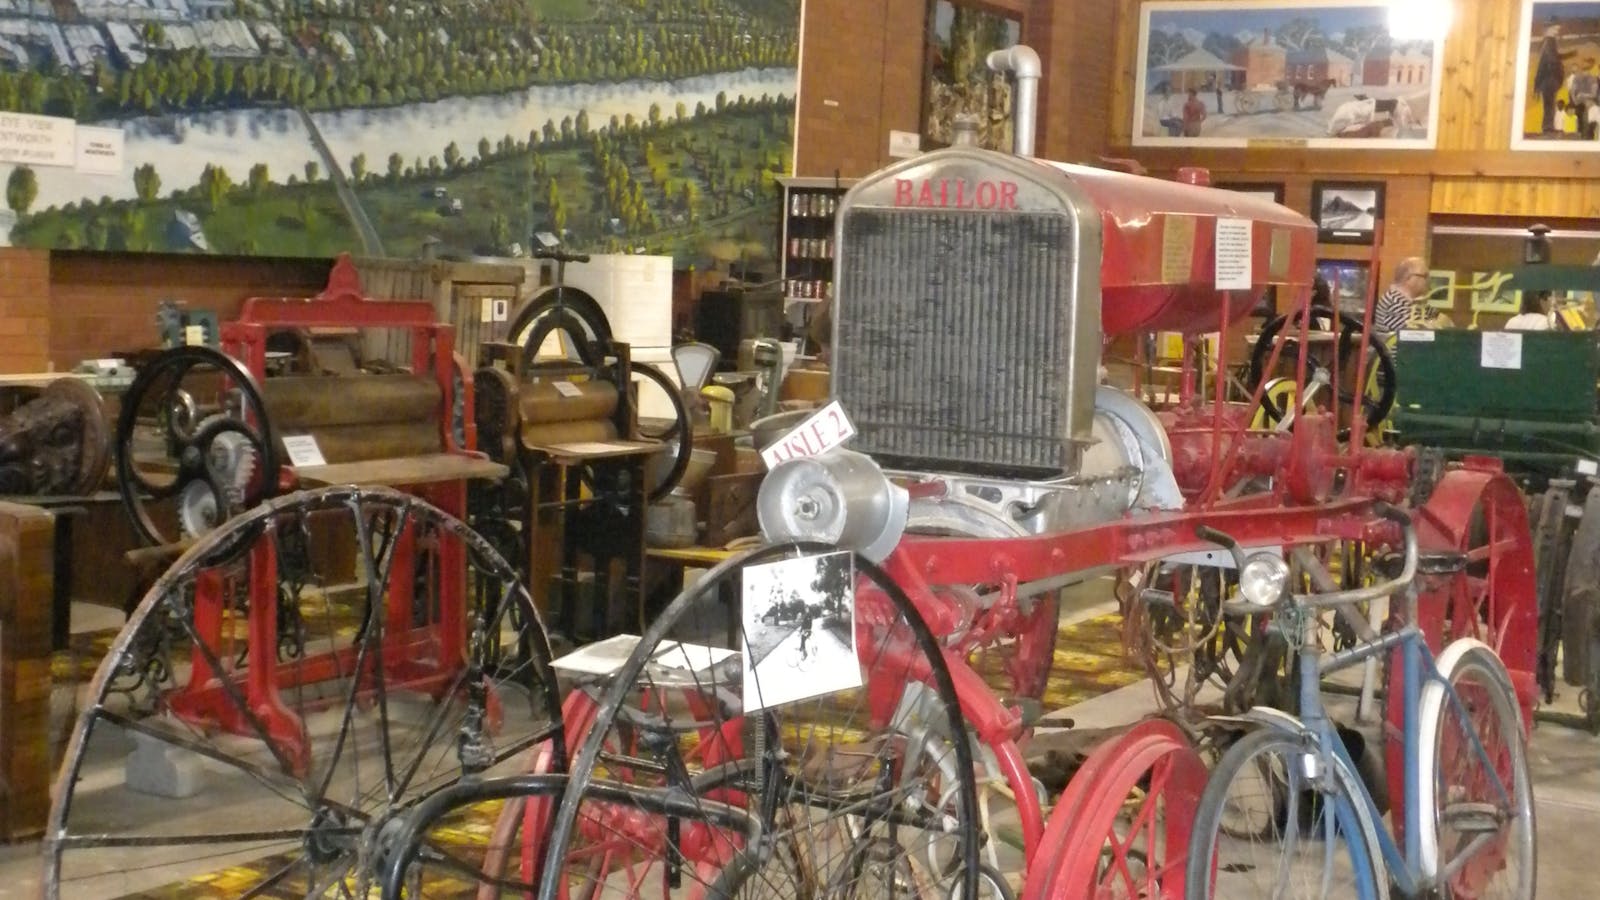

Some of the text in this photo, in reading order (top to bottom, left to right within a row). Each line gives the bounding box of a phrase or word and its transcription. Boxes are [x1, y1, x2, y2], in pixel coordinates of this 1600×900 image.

[0, 131, 52, 144] NTWORTH
[895, 178, 1018, 209] BAILOR
[772, 410, 847, 464] AISLE 2
